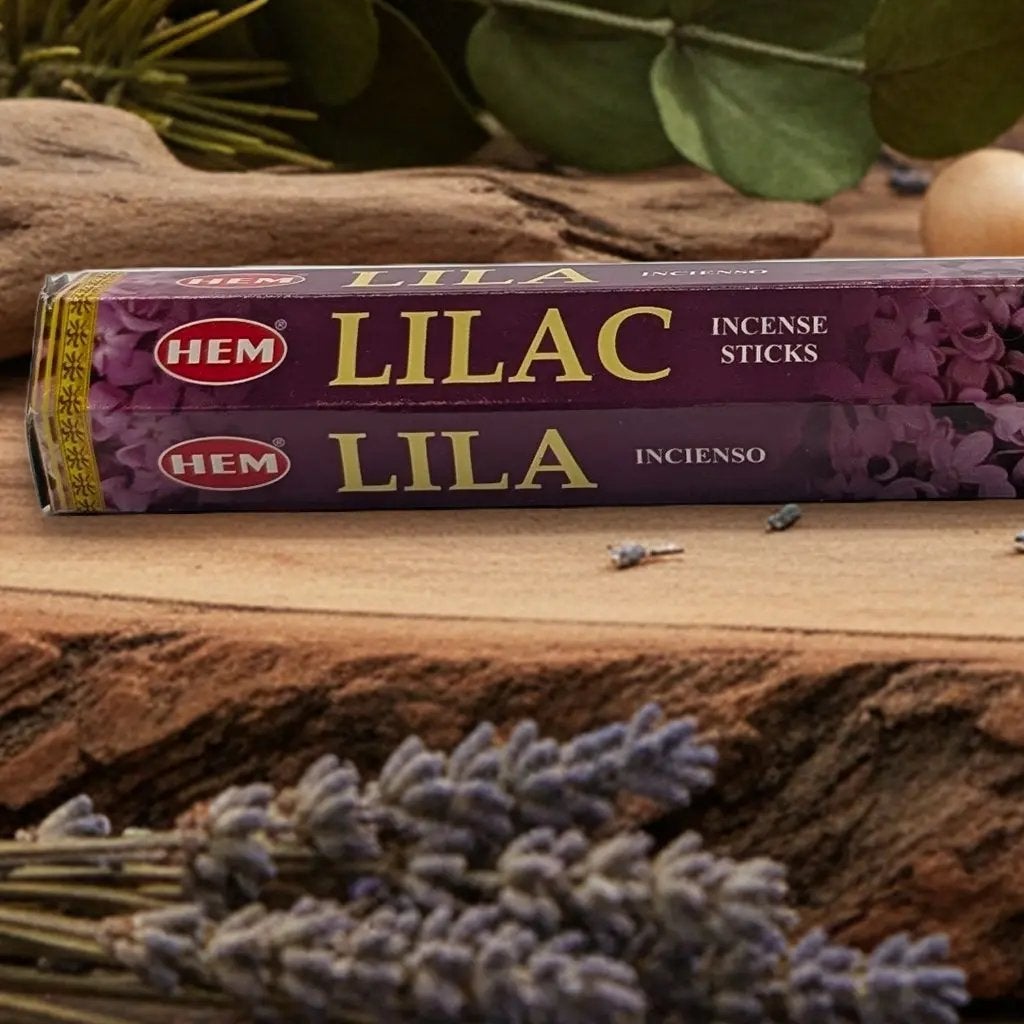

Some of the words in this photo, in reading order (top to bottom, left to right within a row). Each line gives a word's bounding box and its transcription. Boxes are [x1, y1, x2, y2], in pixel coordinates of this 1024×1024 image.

[186, 276, 295, 286] HEM
[342, 268, 599, 287] LILA
[641, 268, 769, 277] INCIENSO
[711, 315, 828, 336] INCENSE
[166, 337, 275, 364] HEM
[328, 306, 673, 387] LILAC
[720, 343, 819, 364] STICKS
[169, 452, 279, 475] HEM
[328, 428, 599, 493] LILA
[635, 447, 766, 465] INCIENSO
